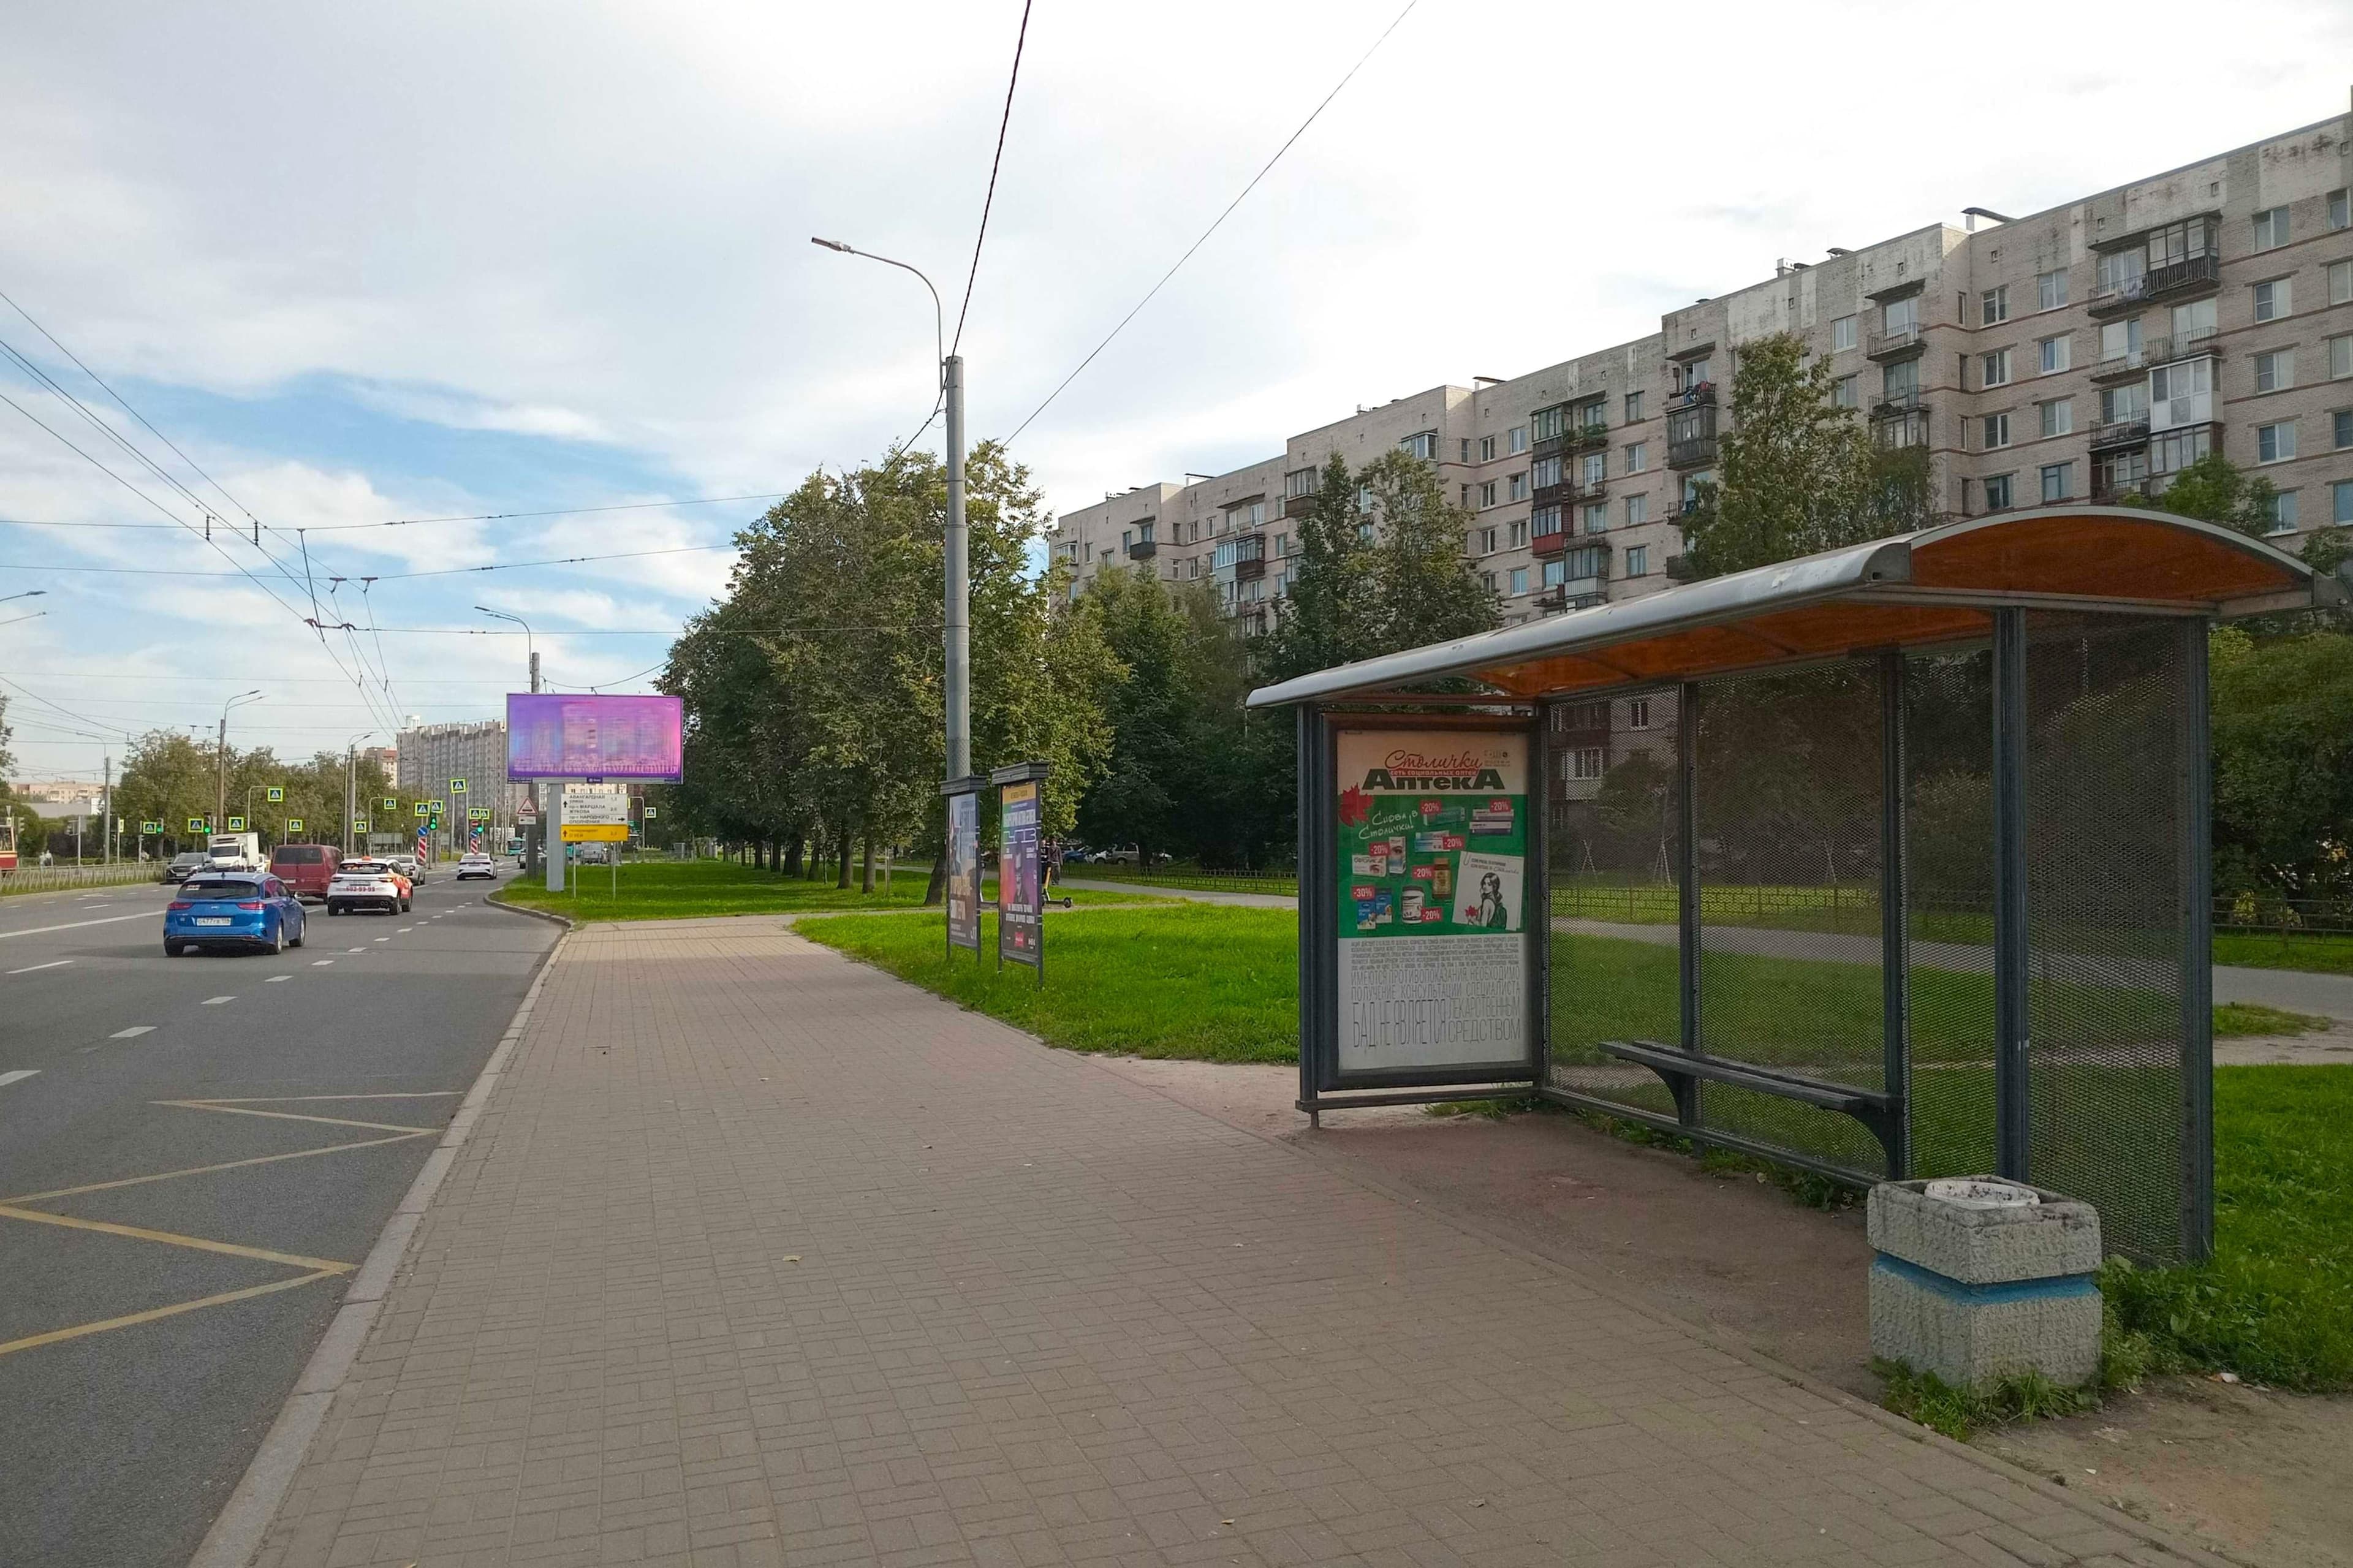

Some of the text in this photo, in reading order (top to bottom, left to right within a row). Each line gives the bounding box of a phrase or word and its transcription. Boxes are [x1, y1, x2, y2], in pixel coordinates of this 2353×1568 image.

[1384, 749, 1483, 768] Столички
[1421, 803, 1439, 812] -20%
[1491, 801, 1509, 811] -20%
[1444, 838, 1463, 847] -20%
[1371, 844, 1389, 854] -20%
[1414, 868, 1432, 877] -20%
[1353, 888, 1373, 897] -30%
[1423, 910, 1440, 920] -20%
[1351, 980, 1520, 1001] ПОЛУЧЕНИЕ КОНСУЛЬТАЦИИ СПЕЦИАЛИСТА
[1352, 999, 1446, 1049] БАД НЕ ЯВЛЯЕТСЯ
[1448, 1018, 1520, 1044] СРЕДСТВОМ
